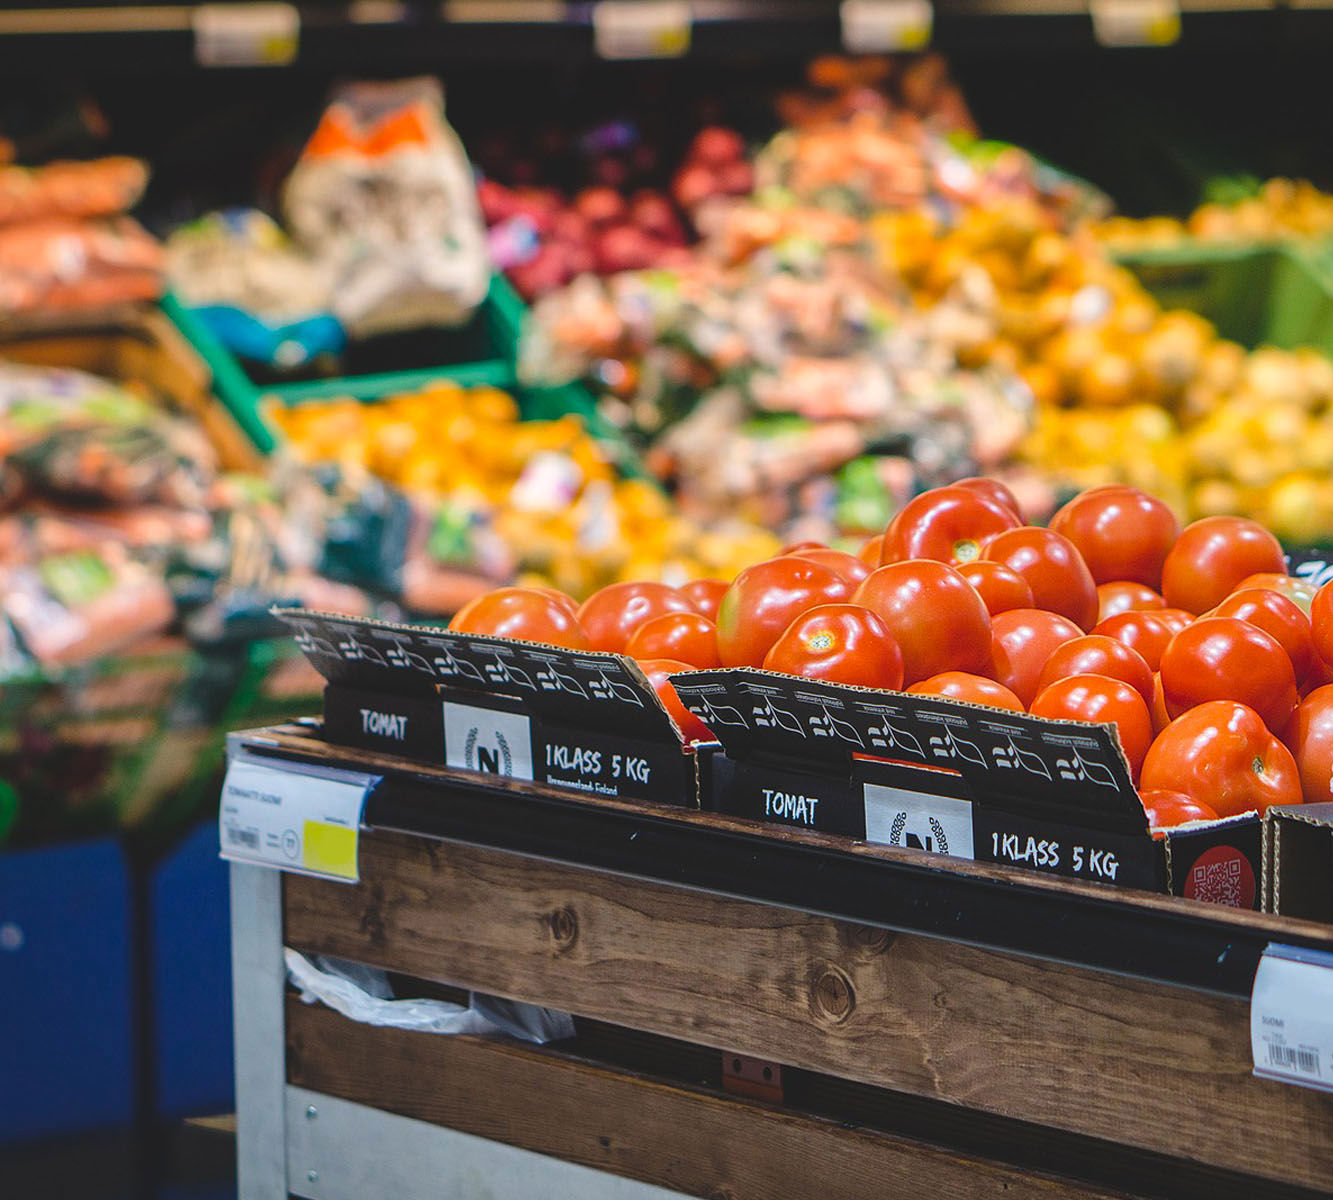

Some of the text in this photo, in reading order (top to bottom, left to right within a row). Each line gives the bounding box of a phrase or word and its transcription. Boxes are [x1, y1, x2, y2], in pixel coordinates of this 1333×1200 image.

[360, 708, 408, 741] TOMAT
[477, 746, 499, 774] N
[546, 744, 650, 784] 1 KLASS 5 KG
[762, 788, 818, 824] TOMAT
[992, 832, 1119, 880] 1 KLASS 5 KG
